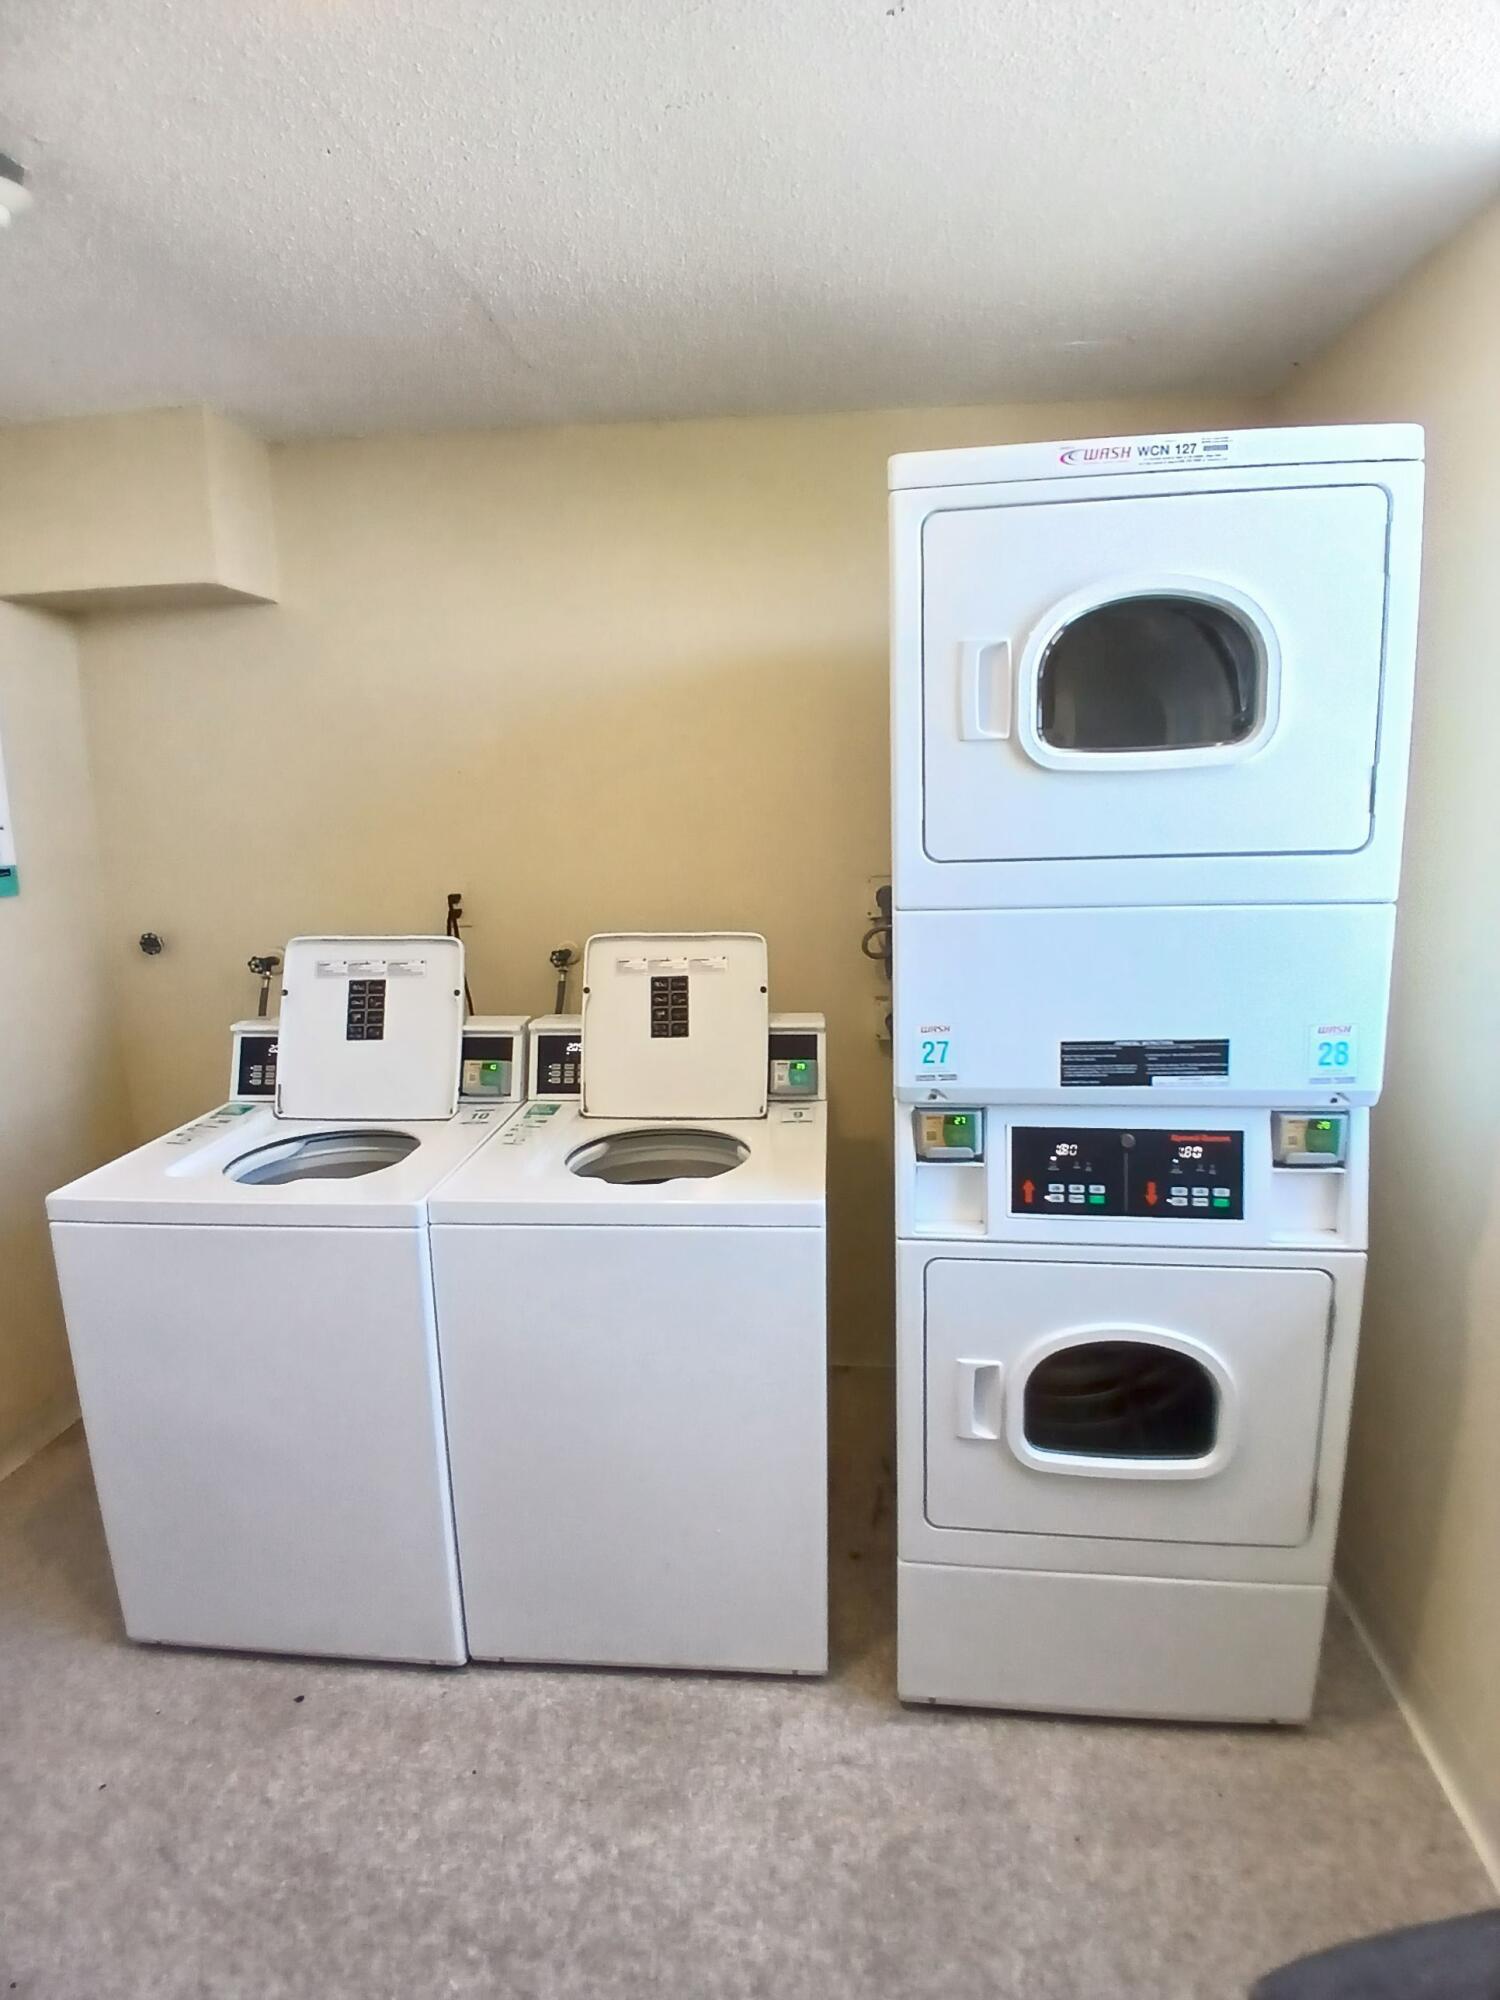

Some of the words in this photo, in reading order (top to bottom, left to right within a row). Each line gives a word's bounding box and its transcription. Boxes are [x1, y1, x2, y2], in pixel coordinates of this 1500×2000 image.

[1083, 446, 1132, 461] WASH
[1136, 445, 1170, 457] WCN
[1175, 443, 1197, 455] 127
[922, 1040, 950, 1064] 27
[1317, 1041, 1349, 1067] 28
